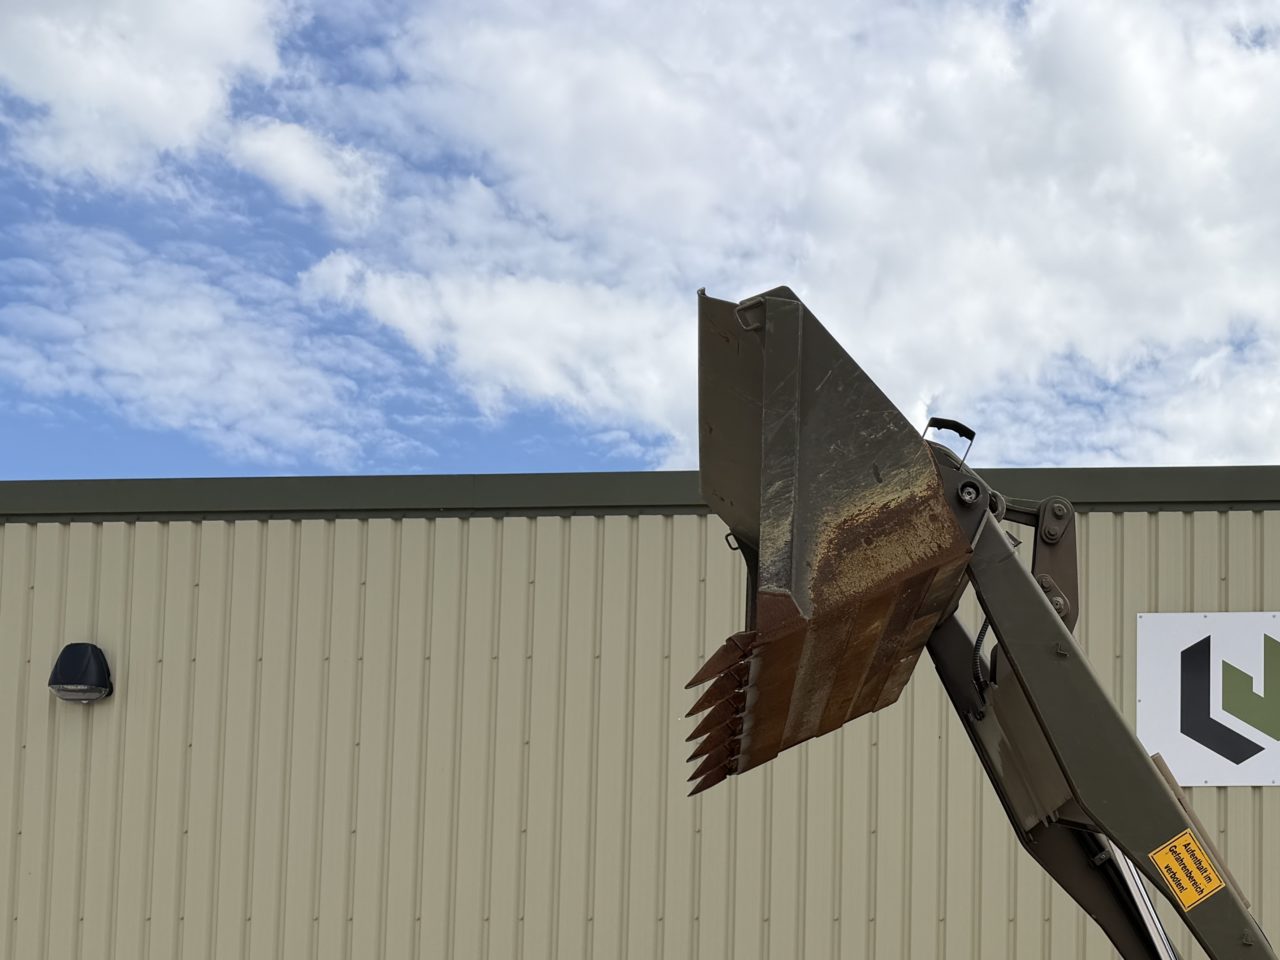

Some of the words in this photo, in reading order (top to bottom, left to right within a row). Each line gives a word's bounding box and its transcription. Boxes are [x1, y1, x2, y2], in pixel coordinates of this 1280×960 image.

[1164, 863, 1187, 893] verboten!
[1168, 845, 1204, 895] Gefahrenbereich
[1182, 842, 1208, 875] Aufenthalt
[1203, 872, 1212, 884] im
